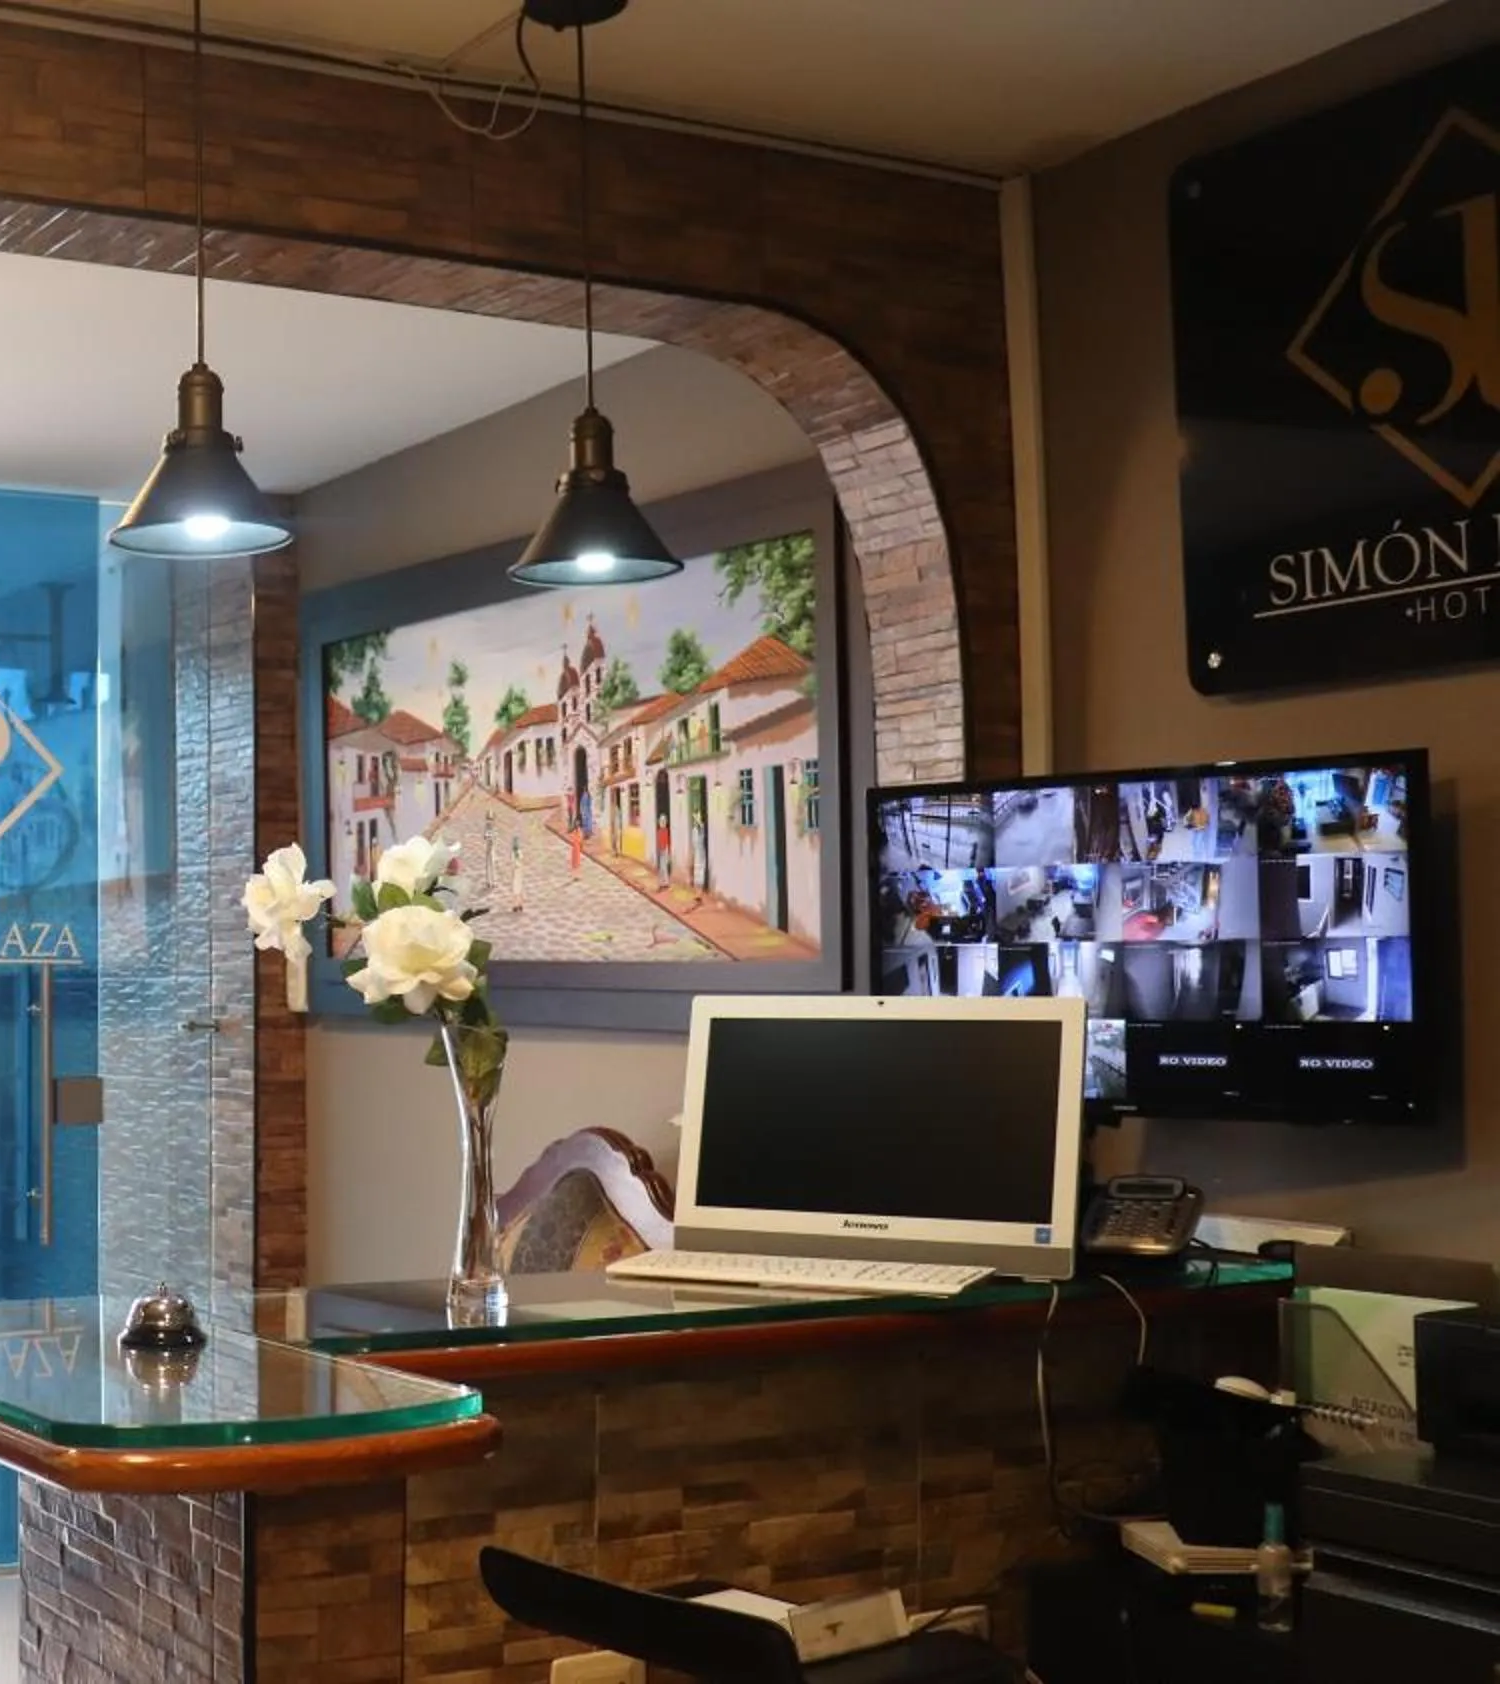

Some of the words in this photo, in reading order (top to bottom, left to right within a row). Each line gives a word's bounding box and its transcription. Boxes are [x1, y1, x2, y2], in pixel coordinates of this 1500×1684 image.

[1268, 518, 1472, 607] SIMÓN
[1159, 1055, 1181, 1066] NO
[1183, 1055, 1228, 1068] VIDEO
[1299, 1058, 1323, 1069] NO
[1326, 1058, 1375, 1071] VIDEO
